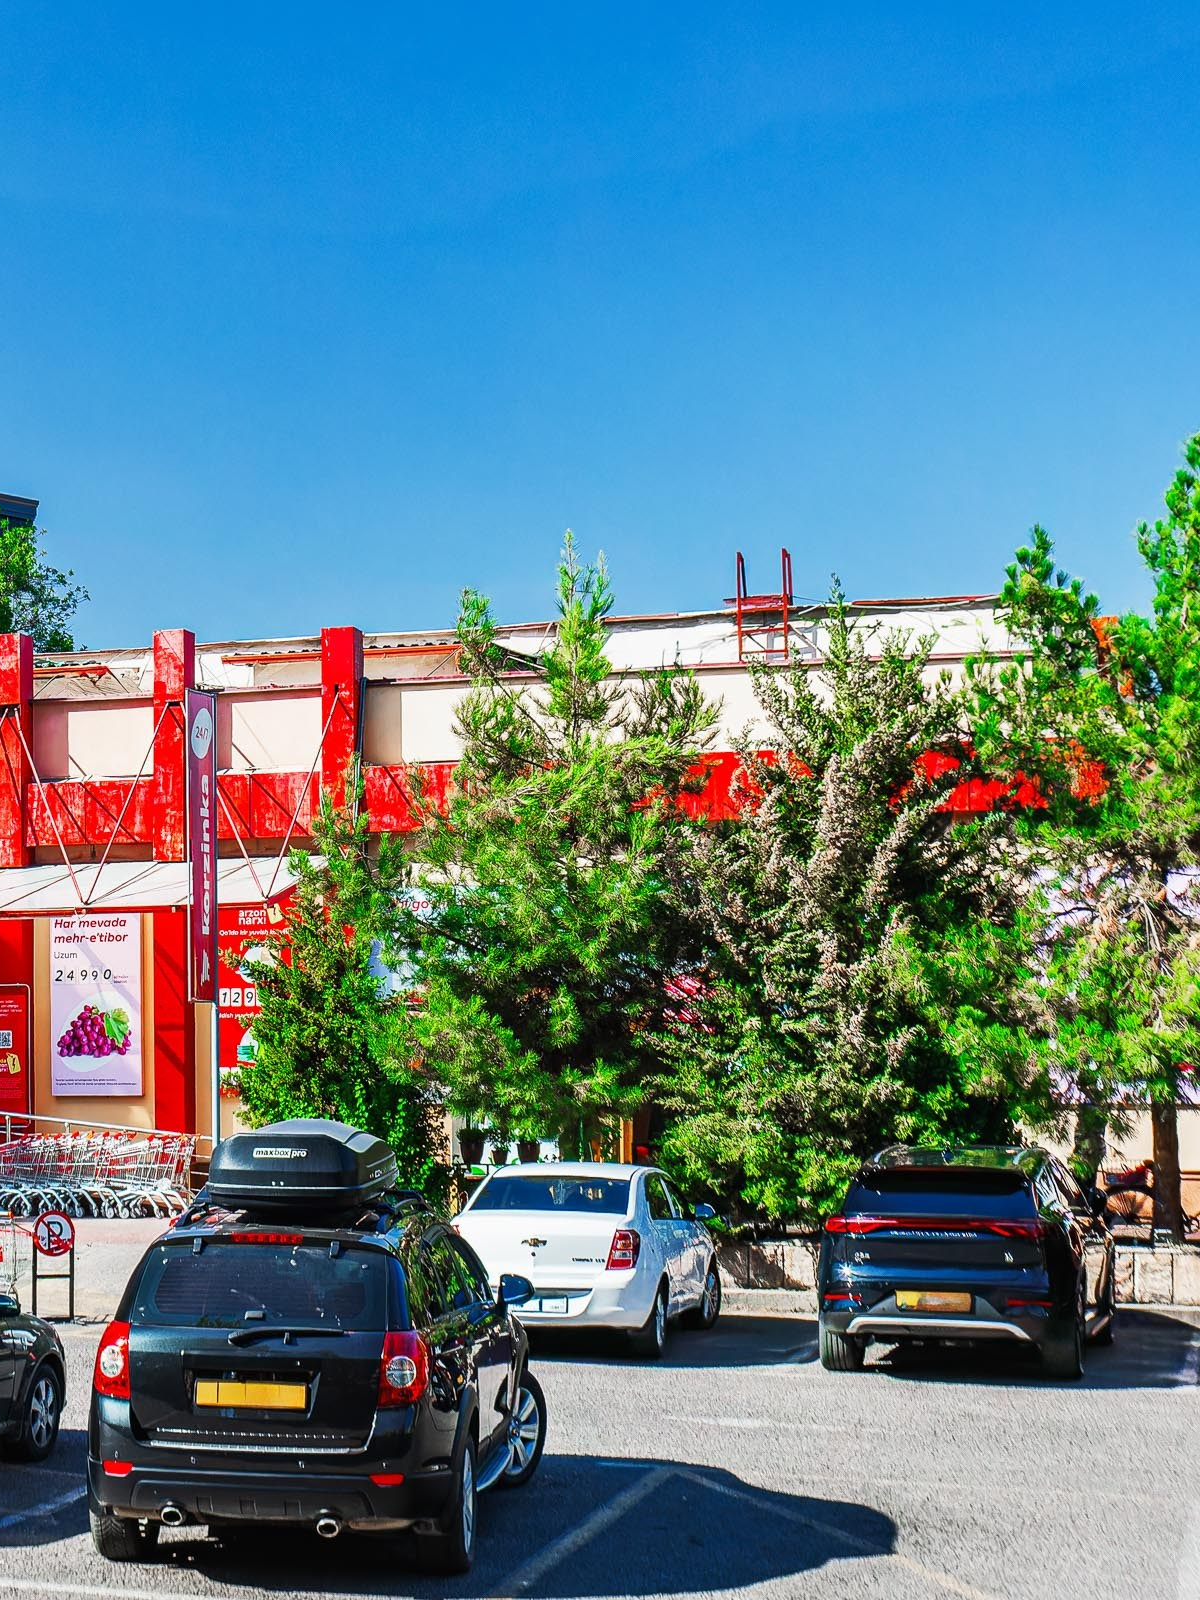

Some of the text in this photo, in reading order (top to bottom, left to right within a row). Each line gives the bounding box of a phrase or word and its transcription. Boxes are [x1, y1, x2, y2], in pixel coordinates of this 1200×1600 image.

[195, 726, 209, 740] 24/7
[200, 774, 210, 935] korzinka
[238, 909, 267, 917] arzon
[54, 917, 127, 929] Har mevada
[53, 951, 78, 959] Uzum
